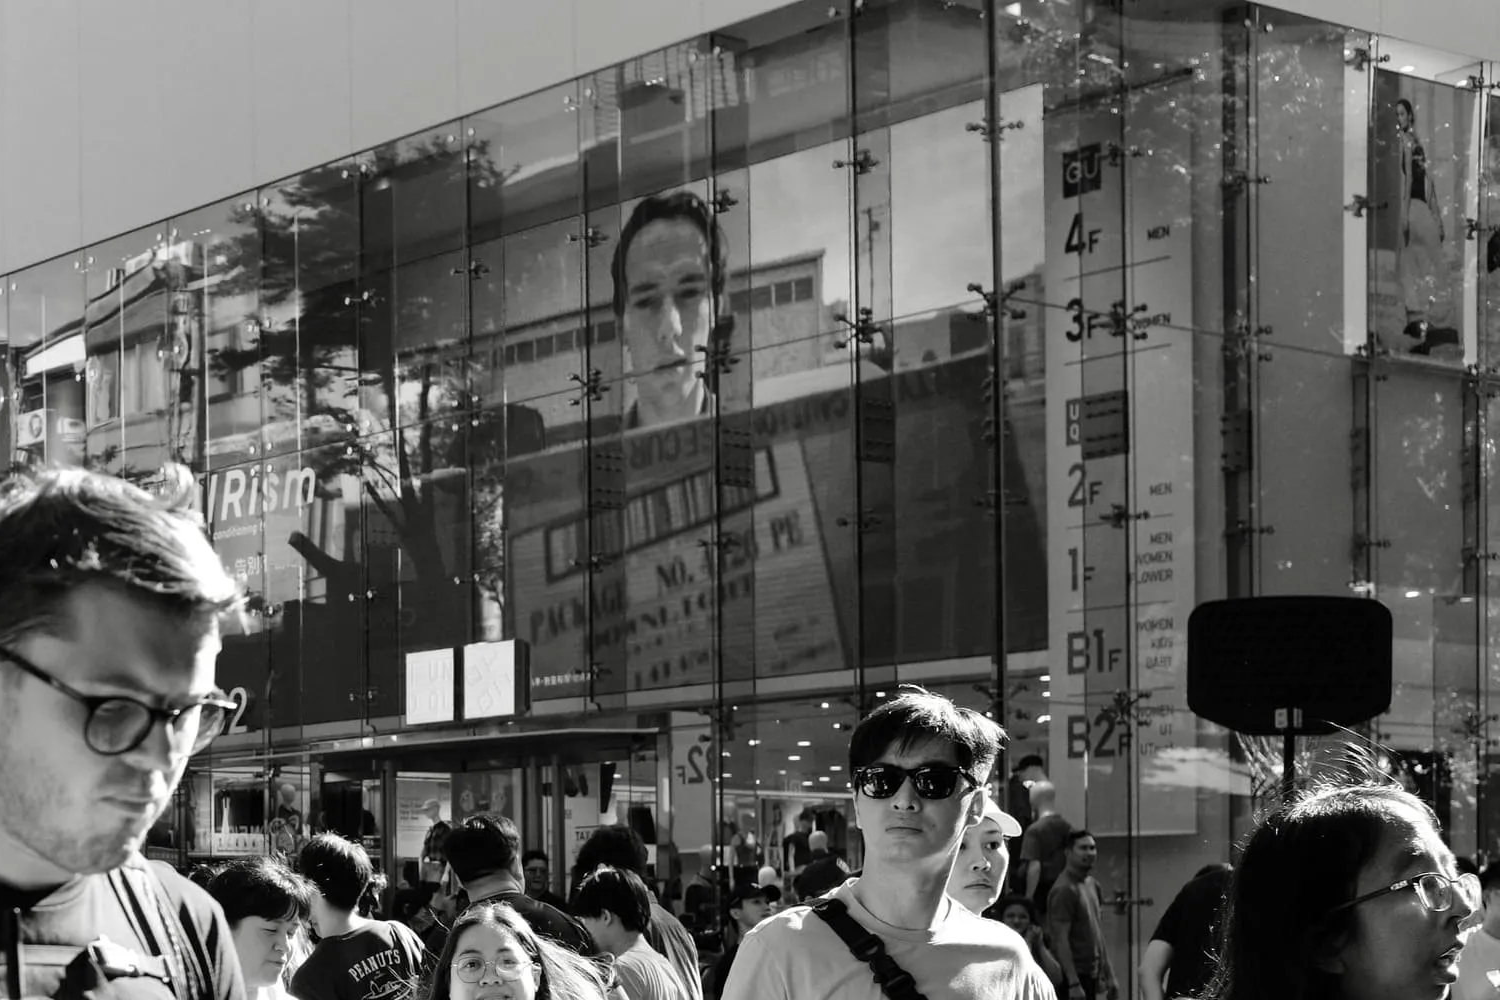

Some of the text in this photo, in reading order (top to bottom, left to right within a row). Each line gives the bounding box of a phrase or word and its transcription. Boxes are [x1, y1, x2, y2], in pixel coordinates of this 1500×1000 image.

[1066, 153, 1098, 184] GU
[1064, 212, 1170, 254] 4F MEN
[1065, 298, 1100, 343] 3F
[1068, 463, 1173, 508] 2F MEN
[1068, 531, 1173, 592] 1F MEN
[1135, 550, 1173, 566] WOMEN
[1067, 628, 1123, 676] B1F
[1067, 711, 1132, 760] B2F
[347, 948, 401, 983] PEANUTS
